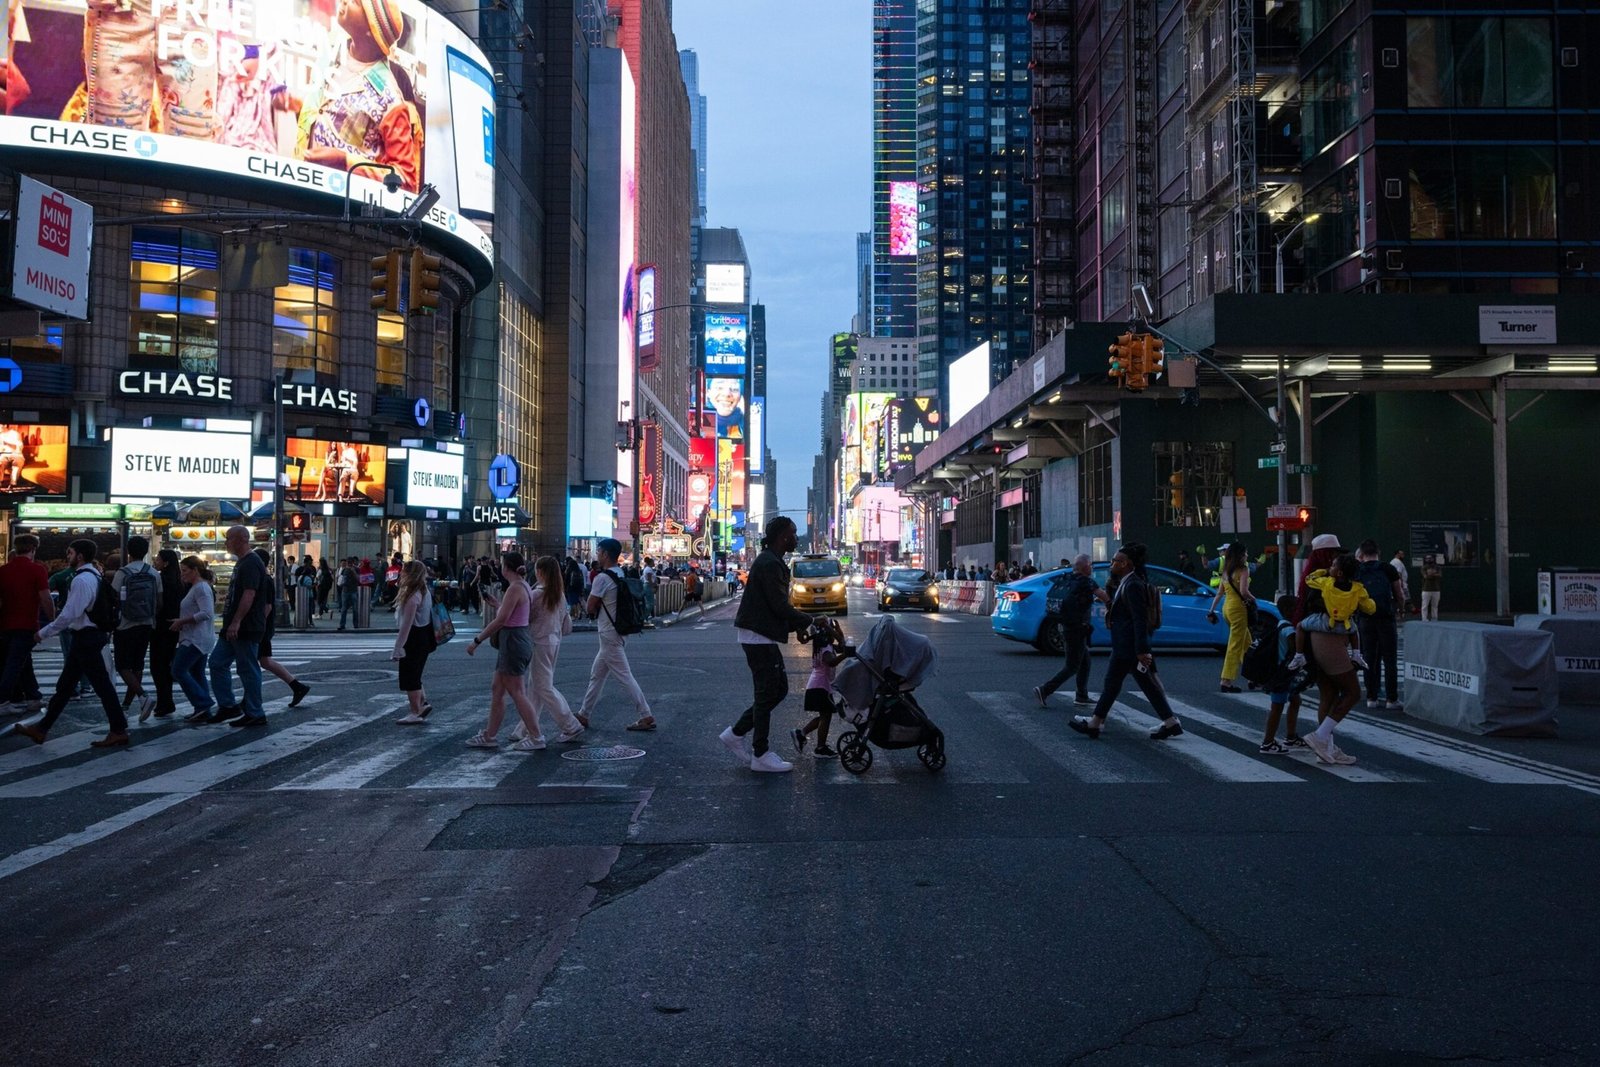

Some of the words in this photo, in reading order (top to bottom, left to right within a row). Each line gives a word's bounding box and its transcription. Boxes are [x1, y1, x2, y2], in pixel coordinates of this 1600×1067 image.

[157, 24, 249, 78] FOR
[29, 125, 129, 152] CHASE
[247, 155, 325, 187] CHASE
[43, 204, 70, 229] MINI
[26, 266, 76, 301] MINISO
[1498, 321, 1537, 333] Turner
[119, 371, 233, 400] CHASE
[125, 454, 172, 473] STEVE
[178, 456, 240, 475] MADDEN
[1303, 465, 1311, 474] 42
[412, 471, 432, 487] STEVE
[433, 473, 459, 490] MADDEN
[472, 506, 516, 524] CHASE
[1564, 582, 1582, 593] LITTLE
[1584, 583, 1598, 593] SHOP
[1564, 594, 1598, 611] HORRORS
[1565, 658, 1600, 670] TIM
[1410, 664, 1436, 682] TIMES
[1438, 670, 1472, 690] SQUARE
